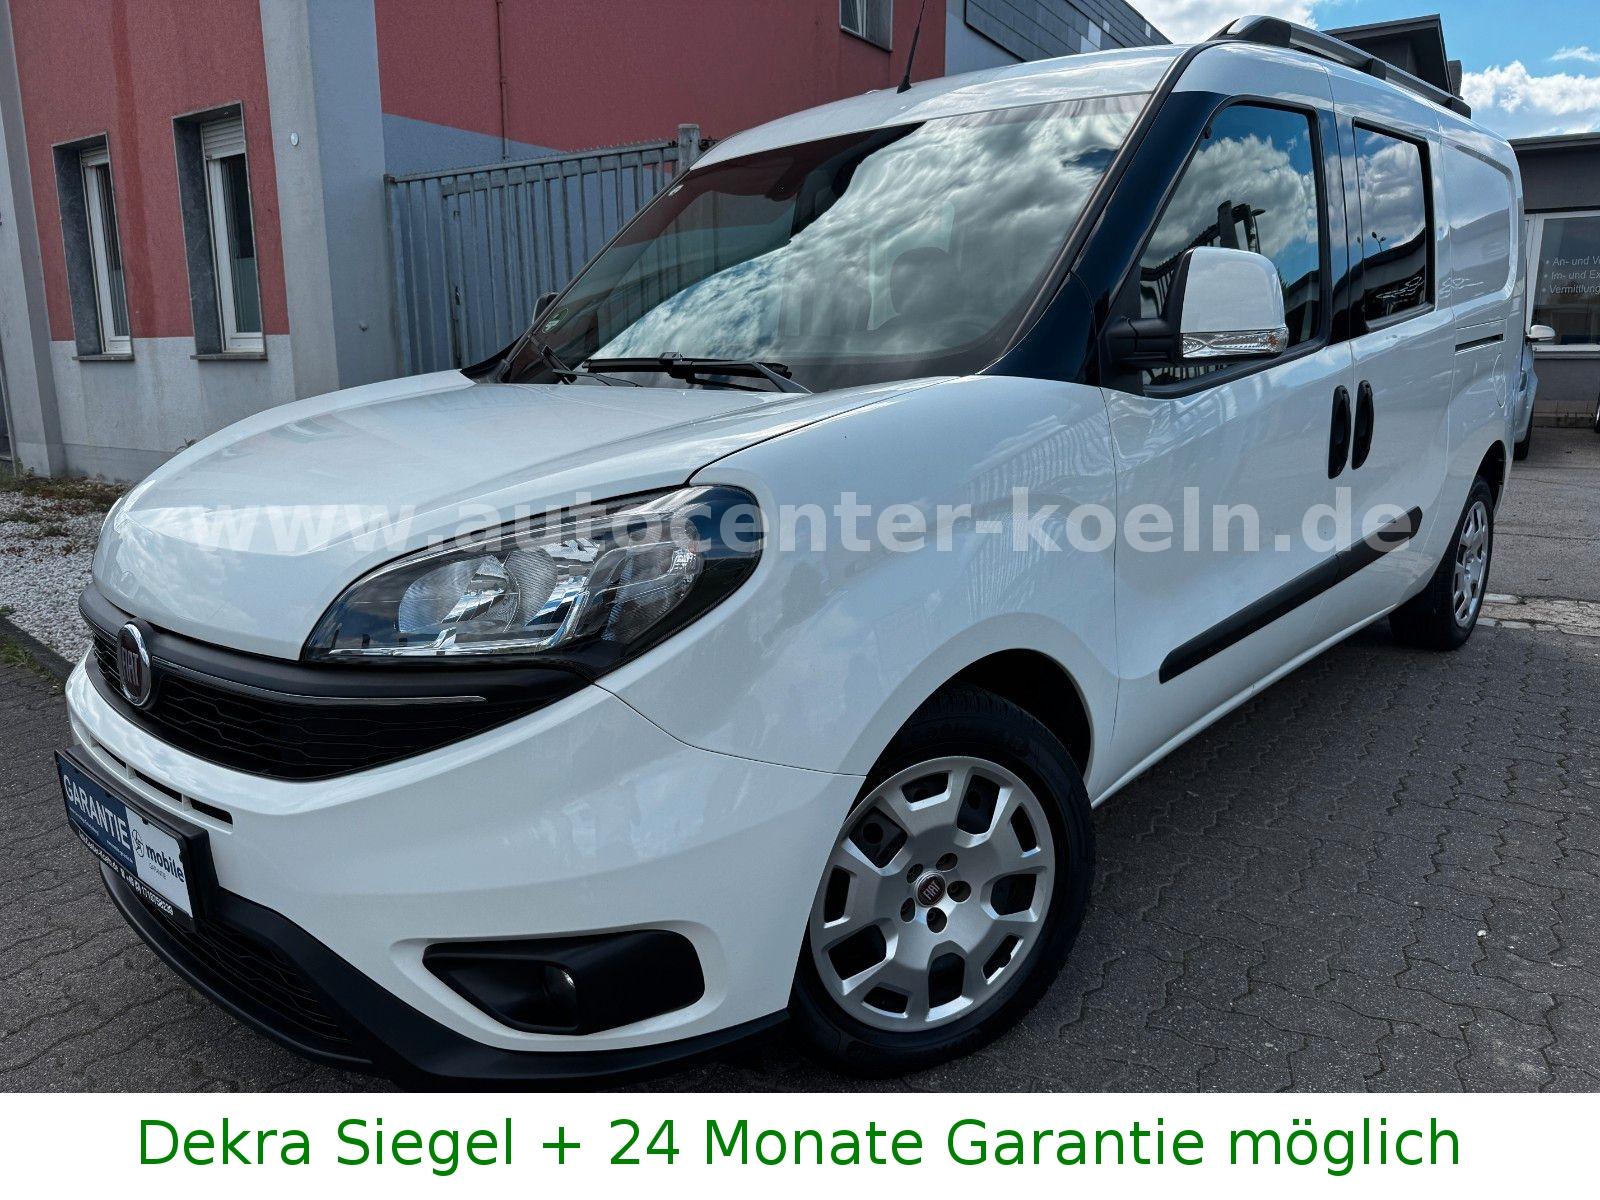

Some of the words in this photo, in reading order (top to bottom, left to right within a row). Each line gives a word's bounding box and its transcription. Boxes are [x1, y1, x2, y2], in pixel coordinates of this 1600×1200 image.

[1551, 271, 1566, 280] Im-
[1568, 270, 1587, 280] und
[1552, 256, 1570, 266] An-
[1571, 255, 1590, 266] und
[121, 646, 139, 686] FIAT
[63, 774, 131, 850] GARANTIE
[145, 844, 185, 883] mobile
[923, 880, 941, 901] FIAT
